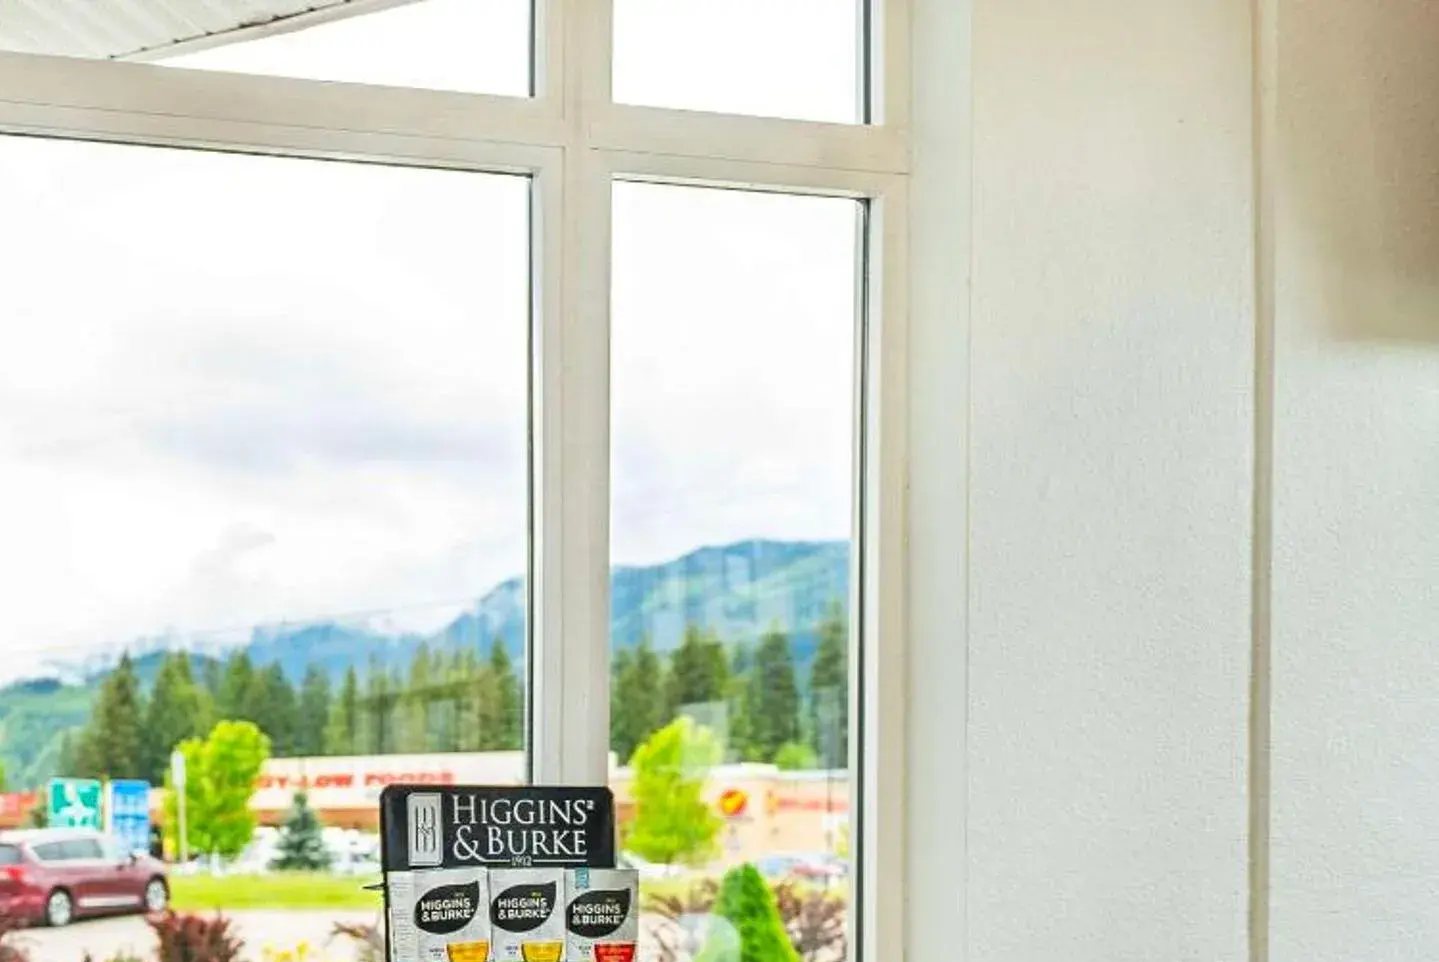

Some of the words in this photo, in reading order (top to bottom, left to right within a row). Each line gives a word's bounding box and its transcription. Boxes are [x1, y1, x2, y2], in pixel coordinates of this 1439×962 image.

[452, 795, 588, 825] HIGGINS
[487, 826, 588, 856] BURKE
[421, 898, 471, 912] HIGGINS
[498, 898, 547, 911] HIGGINS
[573, 903, 620, 914] HIGGINS
